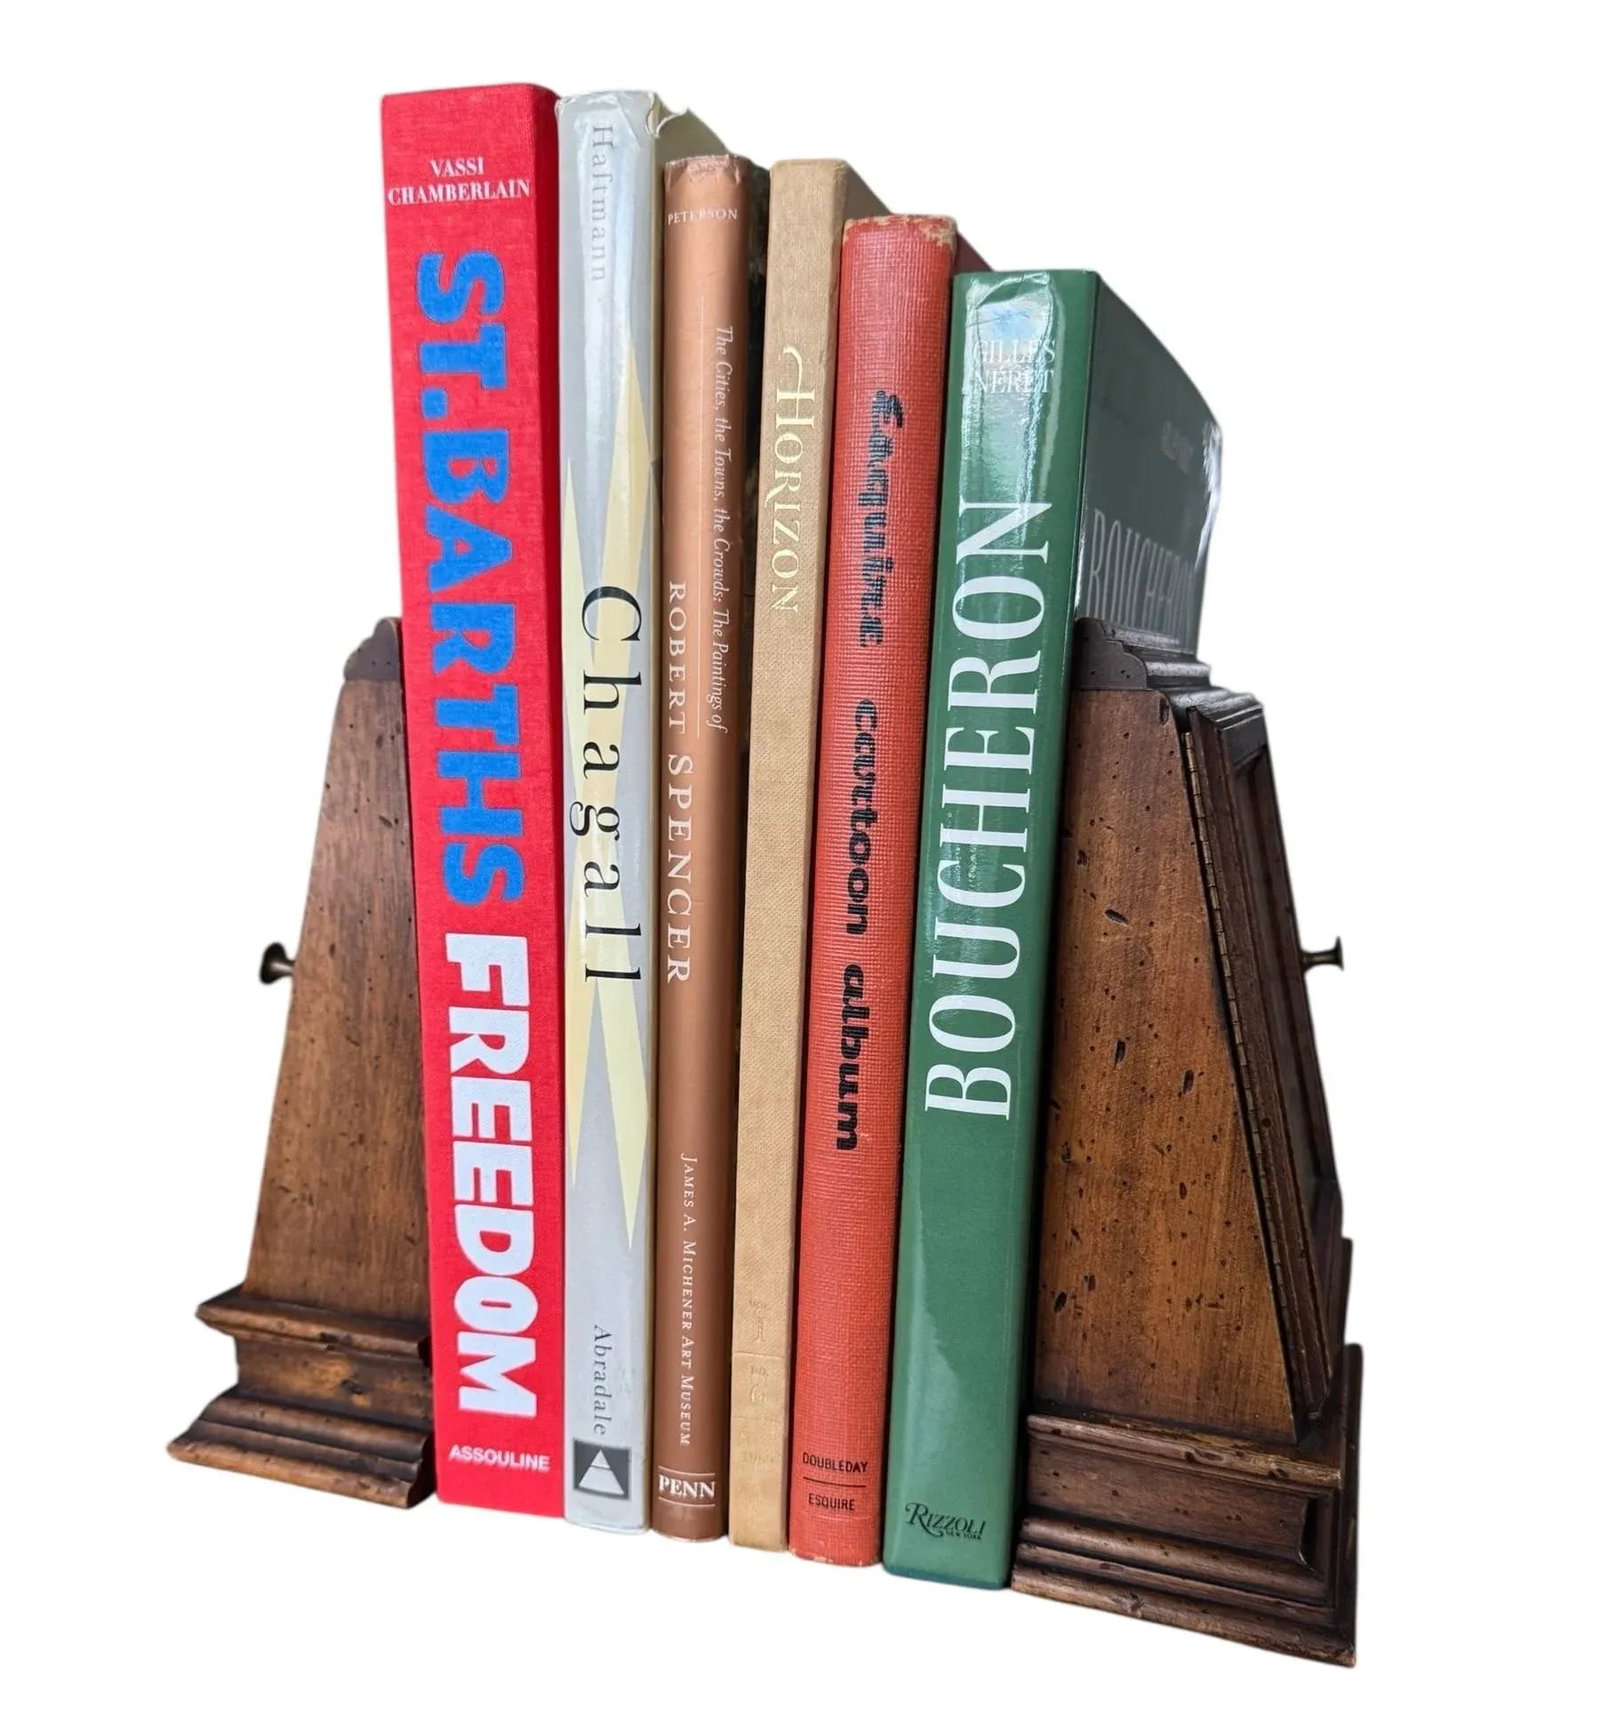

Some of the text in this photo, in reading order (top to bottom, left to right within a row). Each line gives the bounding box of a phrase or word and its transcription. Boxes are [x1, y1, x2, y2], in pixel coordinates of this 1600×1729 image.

[430, 156, 485, 178] VASSI
[388, 178, 532, 207] CHAMBERLAIN
[591, 126, 614, 282] Haftmann
[667, 208, 738, 226] PETERSON
[715, 325, 734, 355] The
[973, 338, 1056, 365] GILLES
[714, 417, 732, 442] the
[713, 448, 732, 502] Towns,
[764, 345, 816, 614] HORIZON
[713, 508, 731, 533] the
[712, 538, 731, 602] Crowds:
[712, 608, 730, 637] The
[706, 641, 730, 710] Paintings
[705, 714, 728, 734] of
[569, 585, 643, 982] Chagall
[666, 580, 694, 983] ROBERT SPENCER
[846, 699, 878, 937] cartoon
[924, 499, 1054, 1122] BOUCHERON
[836, 963, 870, 1151] album
[445, 932, 538, 1418] FREEDOM
[679, 1153, 698, 1448] JAMES A. MICHENER ART MUSEUM
[593, 1324, 613, 1436] Abradale
[448, 1443, 550, 1472] ASSOULINE
[802, 1451, 868, 1474] DOUBLEDAY
[658, 1474, 716, 1499] PENN
[808, 1492, 856, 1512] ESQUIRE
[905, 1502, 986, 1538] RIZZOLI
